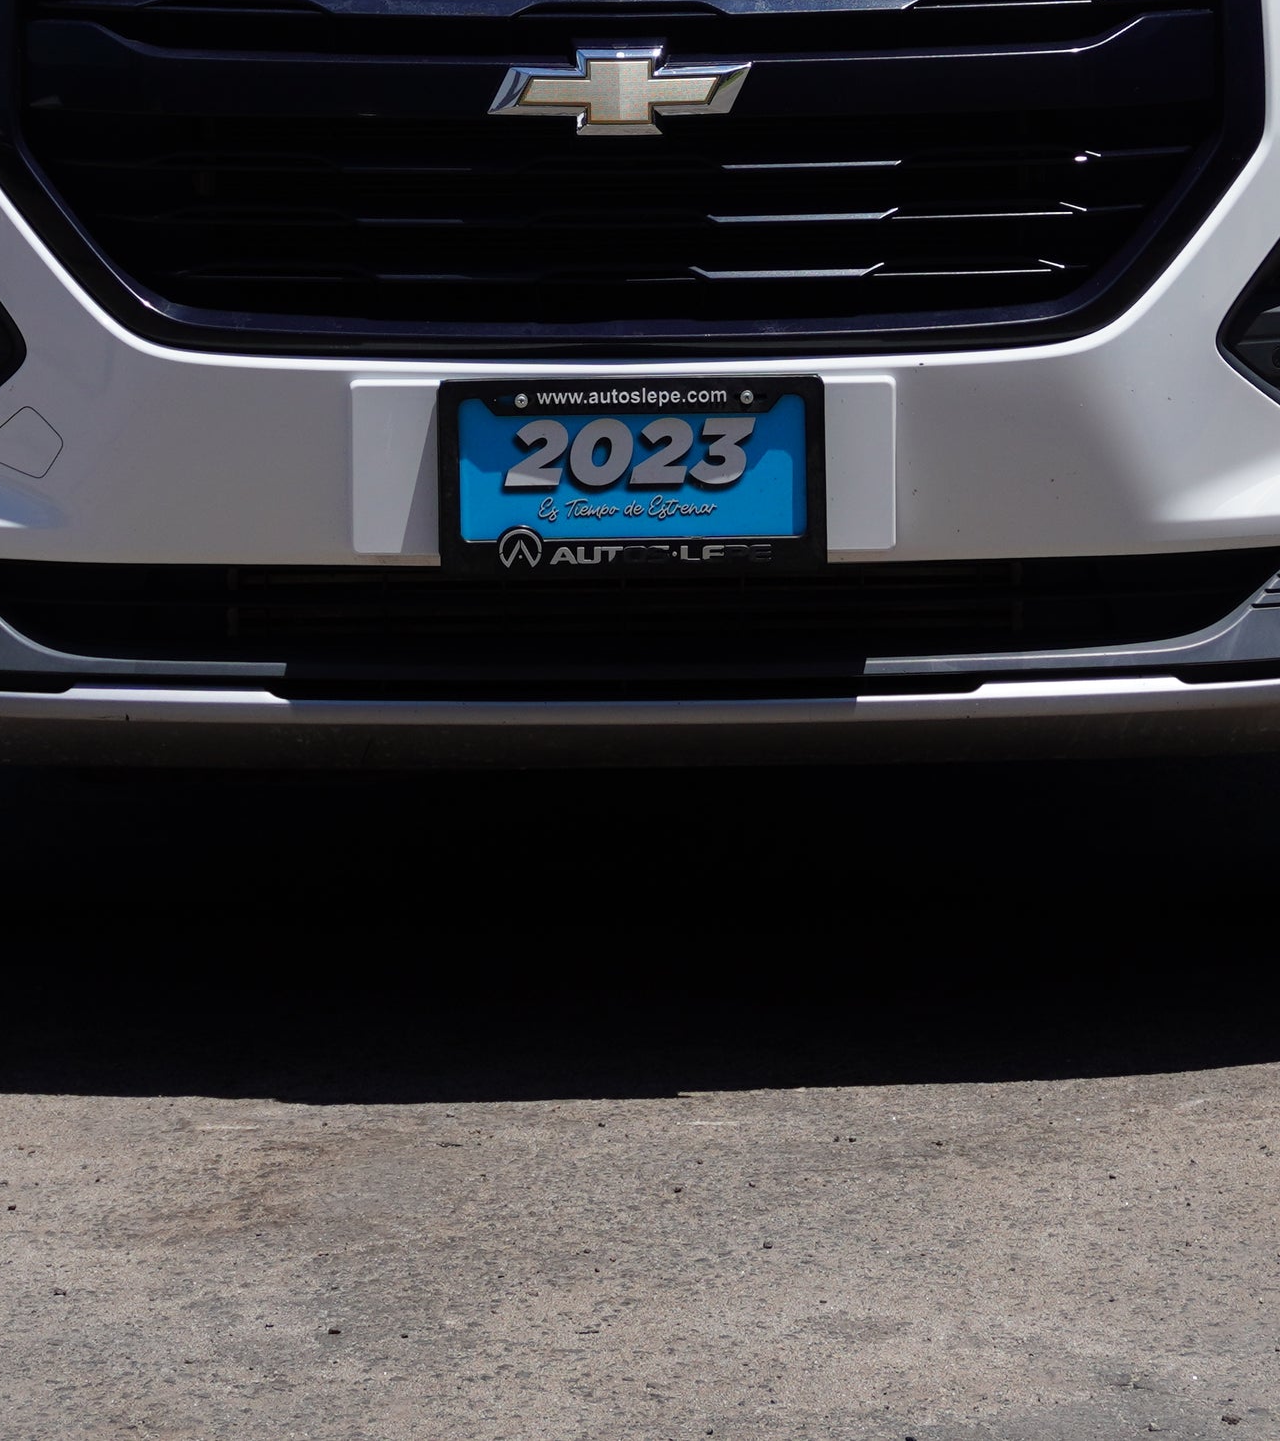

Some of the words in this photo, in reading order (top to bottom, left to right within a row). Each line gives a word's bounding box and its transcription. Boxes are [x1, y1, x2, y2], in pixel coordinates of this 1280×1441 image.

[537, 388, 727, 407] www.autoslepe.com
[503, 416, 757, 489] 2023
[538, 496, 559, 521] Es
[565, 498, 620, 519] Tiempo
[623, 500, 644, 517] de
[648, 494, 718, 519] Estrenar
